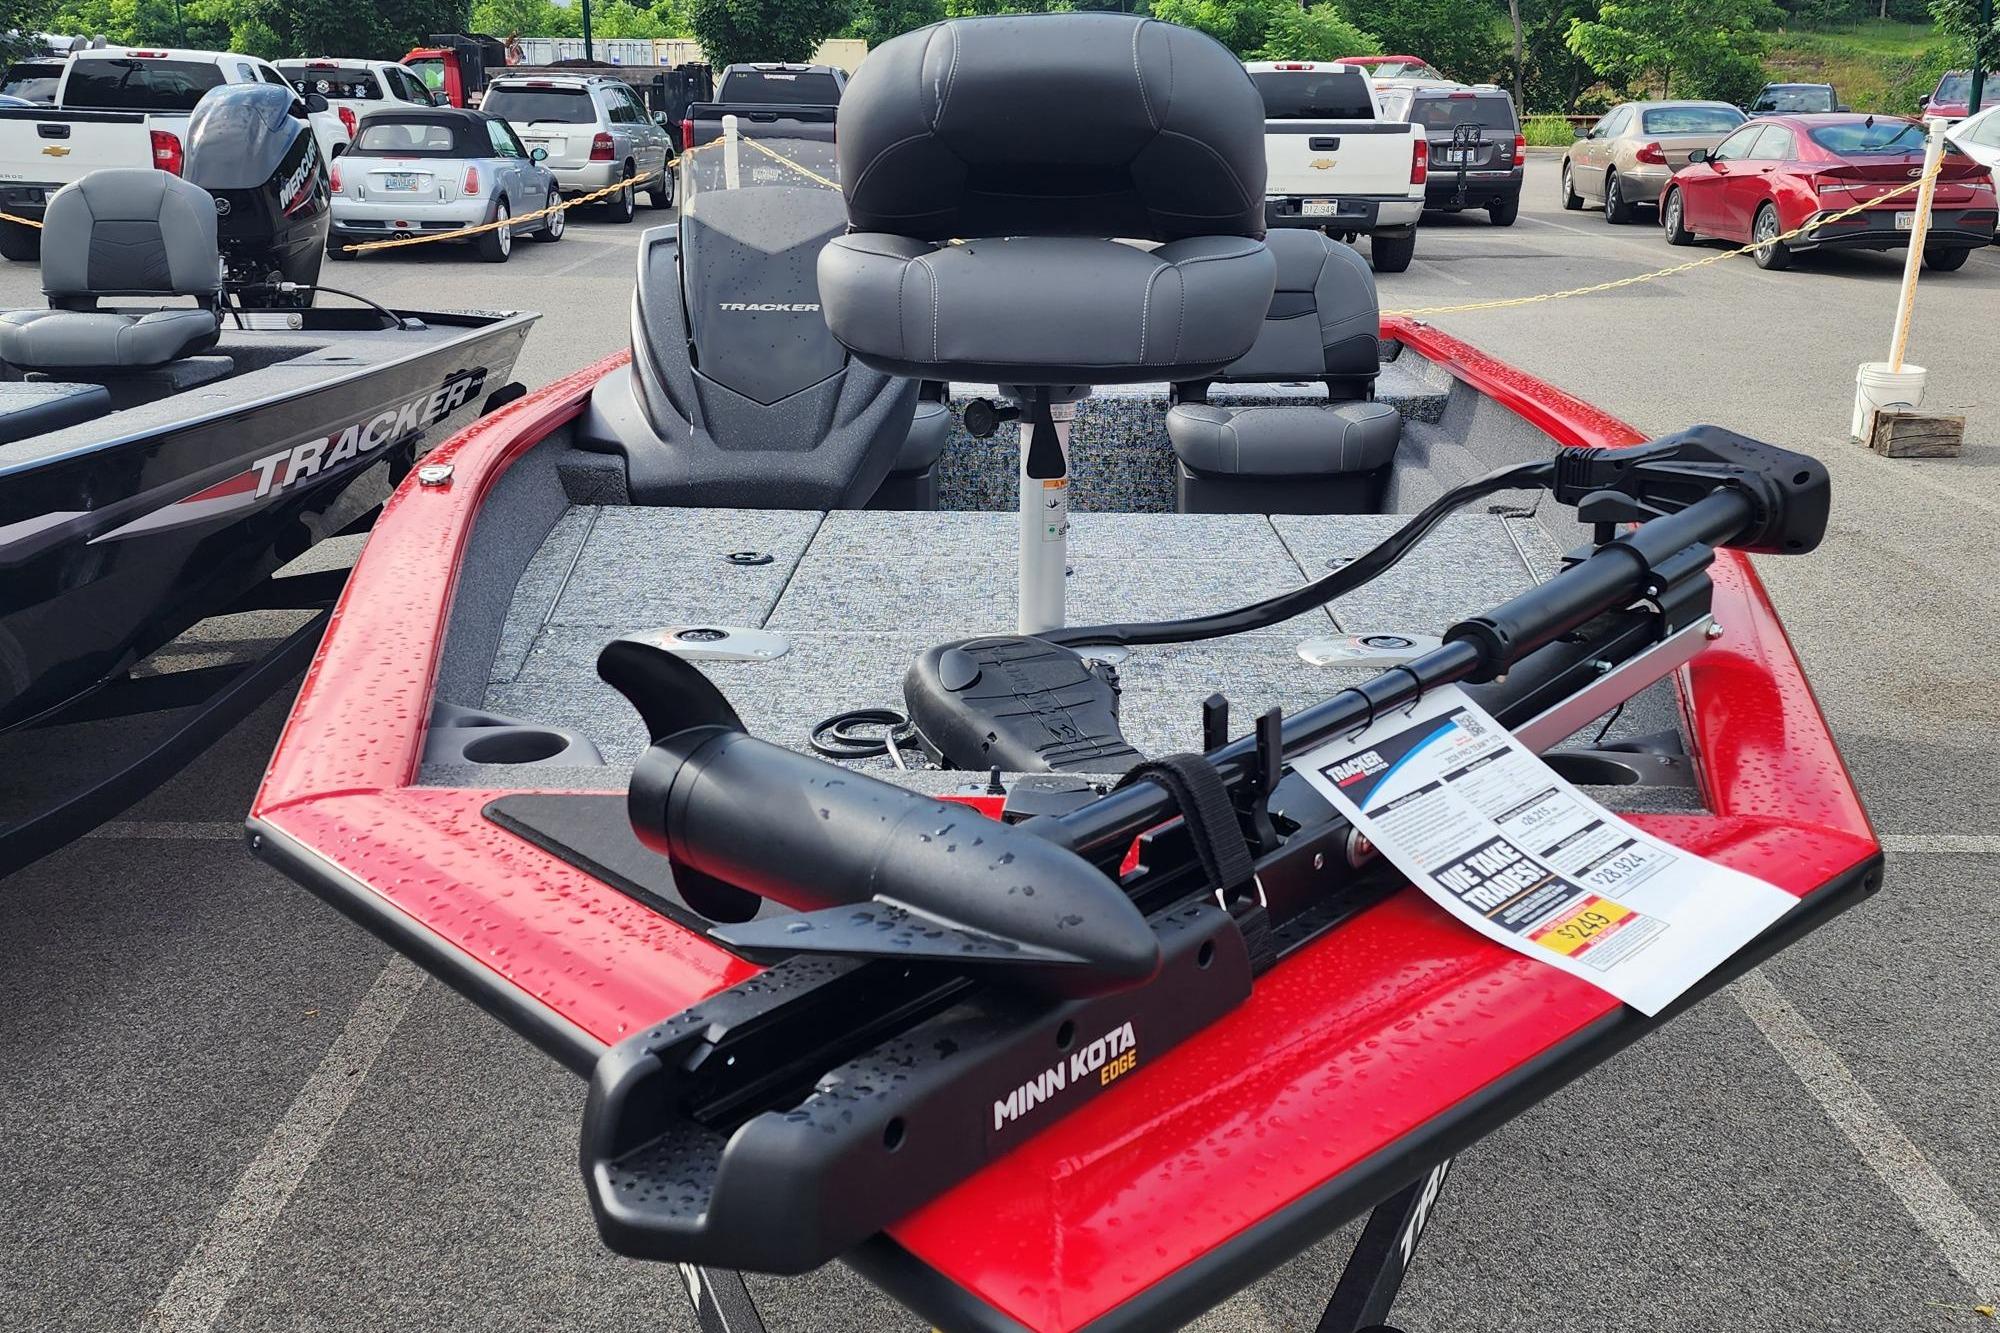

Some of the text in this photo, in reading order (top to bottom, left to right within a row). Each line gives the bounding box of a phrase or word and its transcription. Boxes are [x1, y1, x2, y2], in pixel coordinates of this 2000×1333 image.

[719, 301, 821, 313] TRACKER
[250, 376, 474, 500] TRACKER
[1325, 750, 1384, 782] TRACKER
[1435, 861, 1482, 894] WE
[1463, 840, 1523, 878] TAKE
[1460, 858, 1549, 911] TRADES!
[1590, 852, 1647, 885] $28,924
[1557, 911, 1611, 939] $249
[993, 1021, 1137, 1132] MINN KOTA
[1100, 1049, 1138, 1087] EDGE
